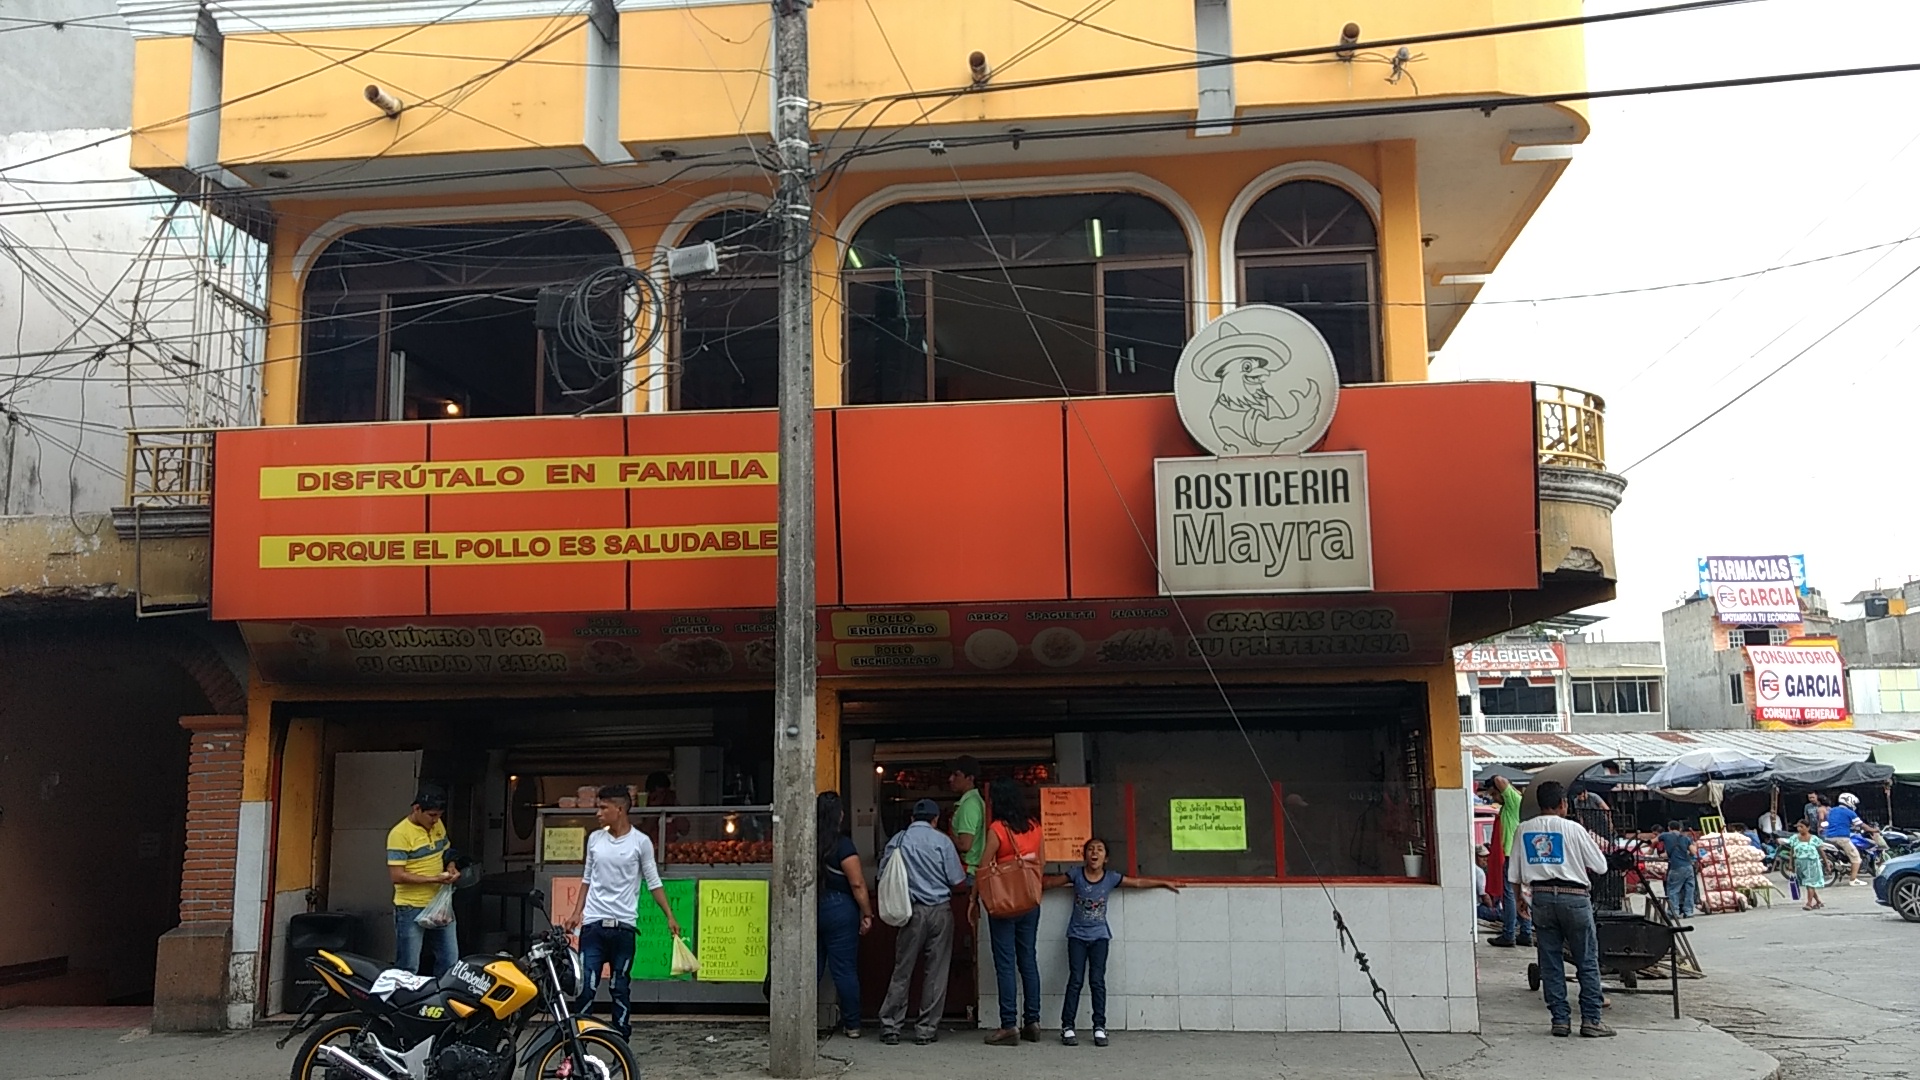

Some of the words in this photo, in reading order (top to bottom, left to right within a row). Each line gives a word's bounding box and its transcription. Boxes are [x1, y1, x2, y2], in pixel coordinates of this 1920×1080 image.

[297, 465, 525, 491] DISFRÚTALO
[546, 463, 596, 484] EN
[619, 459, 769, 482] FAMILIA
[1174, 468, 1350, 510] ROSTICERIA
[288, 540, 405, 561] PORQUE
[413, 540, 448, 559] EL
[455, 538, 550, 558] POLLO
[559, 535, 596, 556] ES
[604, 529, 778, 555] SALUDABLE
[1173, 512, 1354, 577] Mayra
[1709, 558, 1790, 581] FARMACIAS
[1738, 587, 1796, 606] GARCIA
[672, 615, 709, 625] POLLO
[867, 613, 915, 624] POLLO
[967, 611, 1009, 622] ARROZ
[1025, 610, 1096, 621] SPAGUETTI
[1110, 608, 1169, 619] FLAUTAS
[1207, 610, 1325, 632] GRACIAS
[1331, 609, 1394, 630] POR
[346, 628, 387, 648] LOS
[388, 626, 475, 648] NÚMERO
[478, 628, 492, 647] 1
[495, 627, 542, 647] POR
[574, 627, 641, 636] ROSTIZADO
[661, 625, 724, 635] RANCHERO
[848, 624, 938, 637] ENDIABLADO
[875, 644, 914, 655] POLLO
[1188, 637, 1224, 657] SU
[1230, 633, 1409, 657] PREFERENCIA
[851, 655, 939, 667] ENCHIPOTLADO
[1471, 649, 1560, 663] SALGUERO
[1753, 650, 1836, 664] CONSULTORIO
[356, 656, 384, 673] SU
[388, 655, 472, 673] CALIDAD
[475, 655, 492, 672] Y
[498, 655, 568, 673] SABOR
[1785, 674, 1842, 697] GARCIA
[1762, 708, 1801, 719] CONSULTA
[1804, 708, 1840, 720] GENERAL
[711, 888, 756, 904] PAQUETE
[706, 906, 752, 917] FAMILIAR
[714, 925, 734, 934] POLLO
